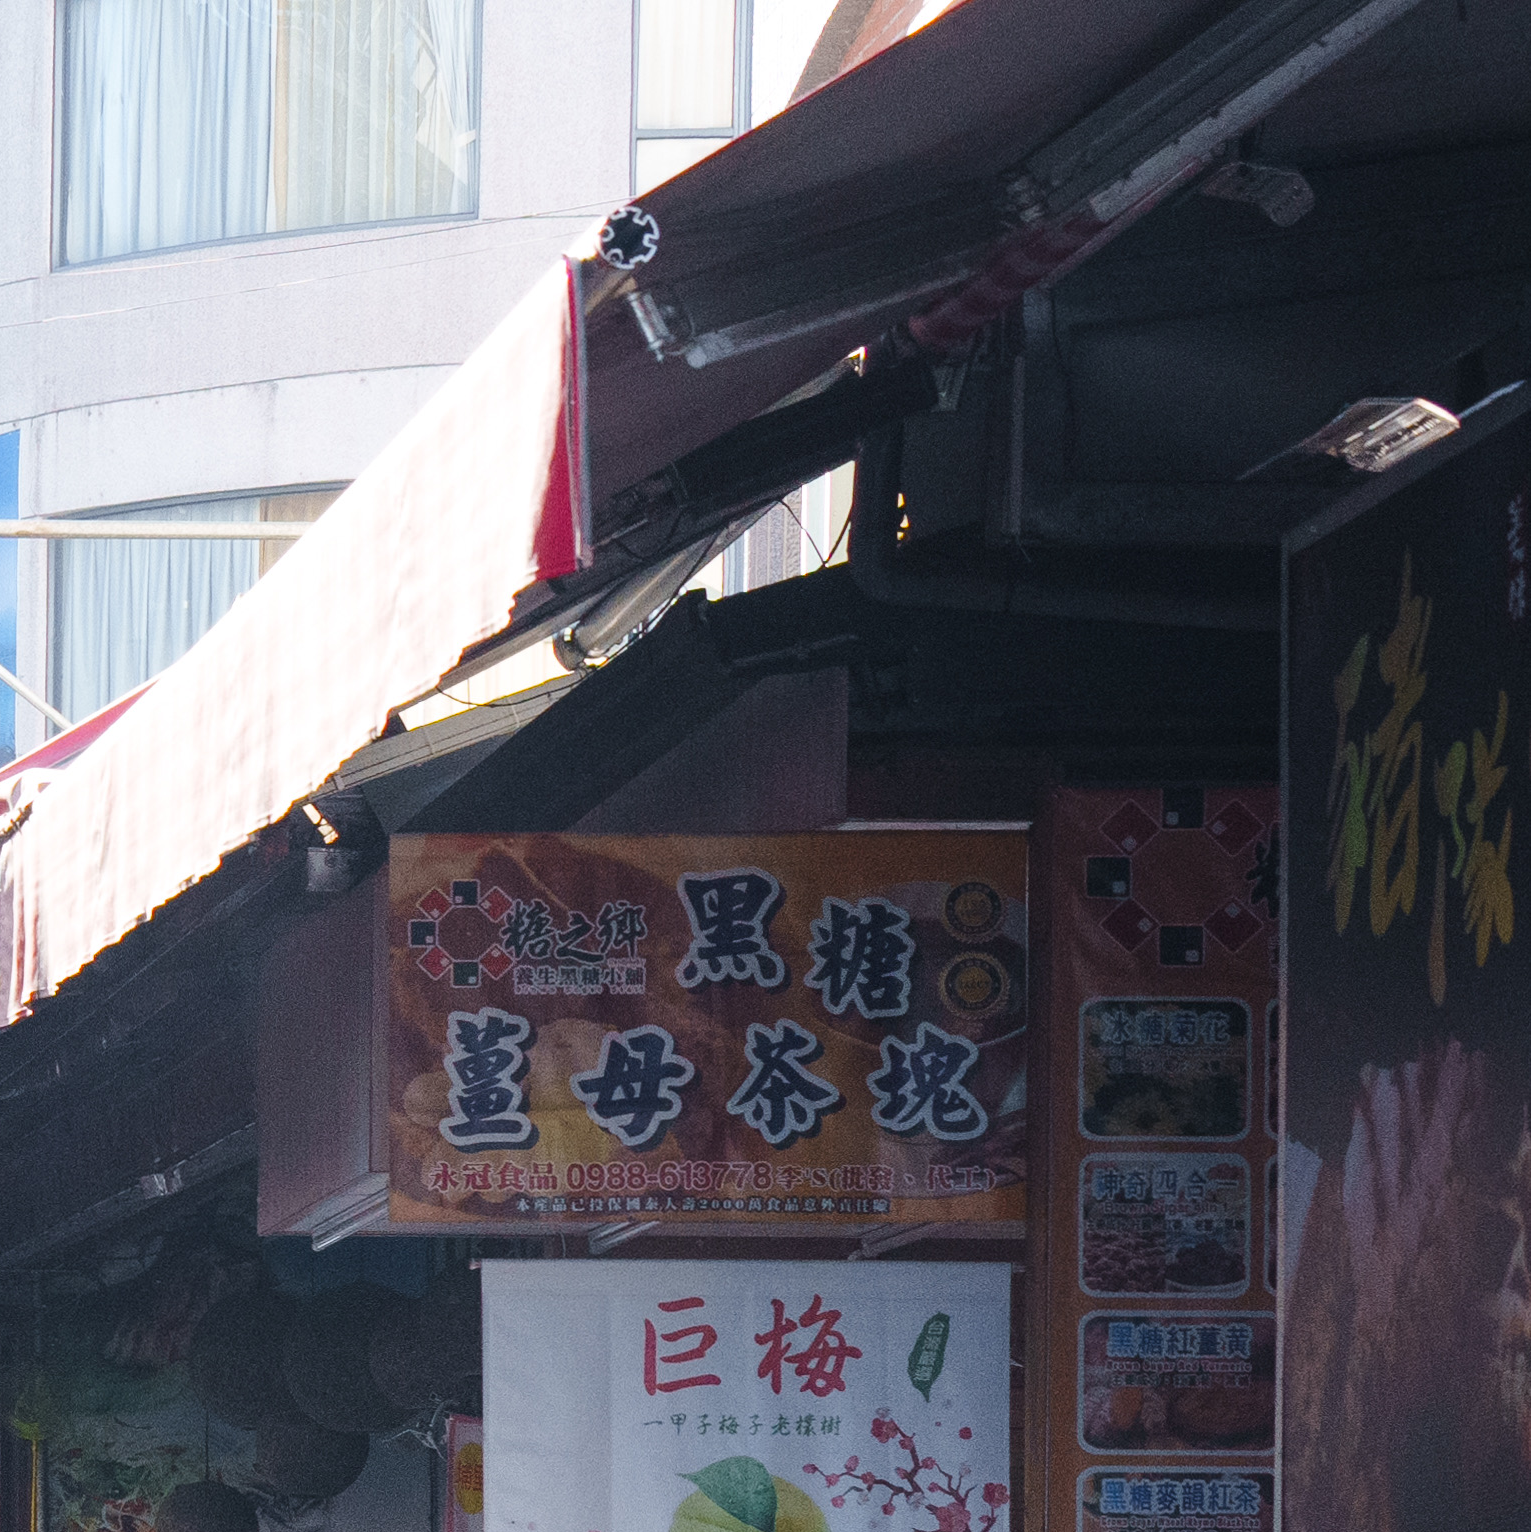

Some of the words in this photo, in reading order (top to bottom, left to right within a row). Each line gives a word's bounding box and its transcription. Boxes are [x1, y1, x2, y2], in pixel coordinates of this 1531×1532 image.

[500, 900, 647, 963] 糖之鄉
[679, 866, 918, 1020] 黑糖
[438, 1006, 989, 1150] 薑母茶塊
[428, 1162, 557, 1192] 永冠食品
[567, 1162, 770, 1191] 0988-613778
[643, 1294, 863, 1397] 巨梅
